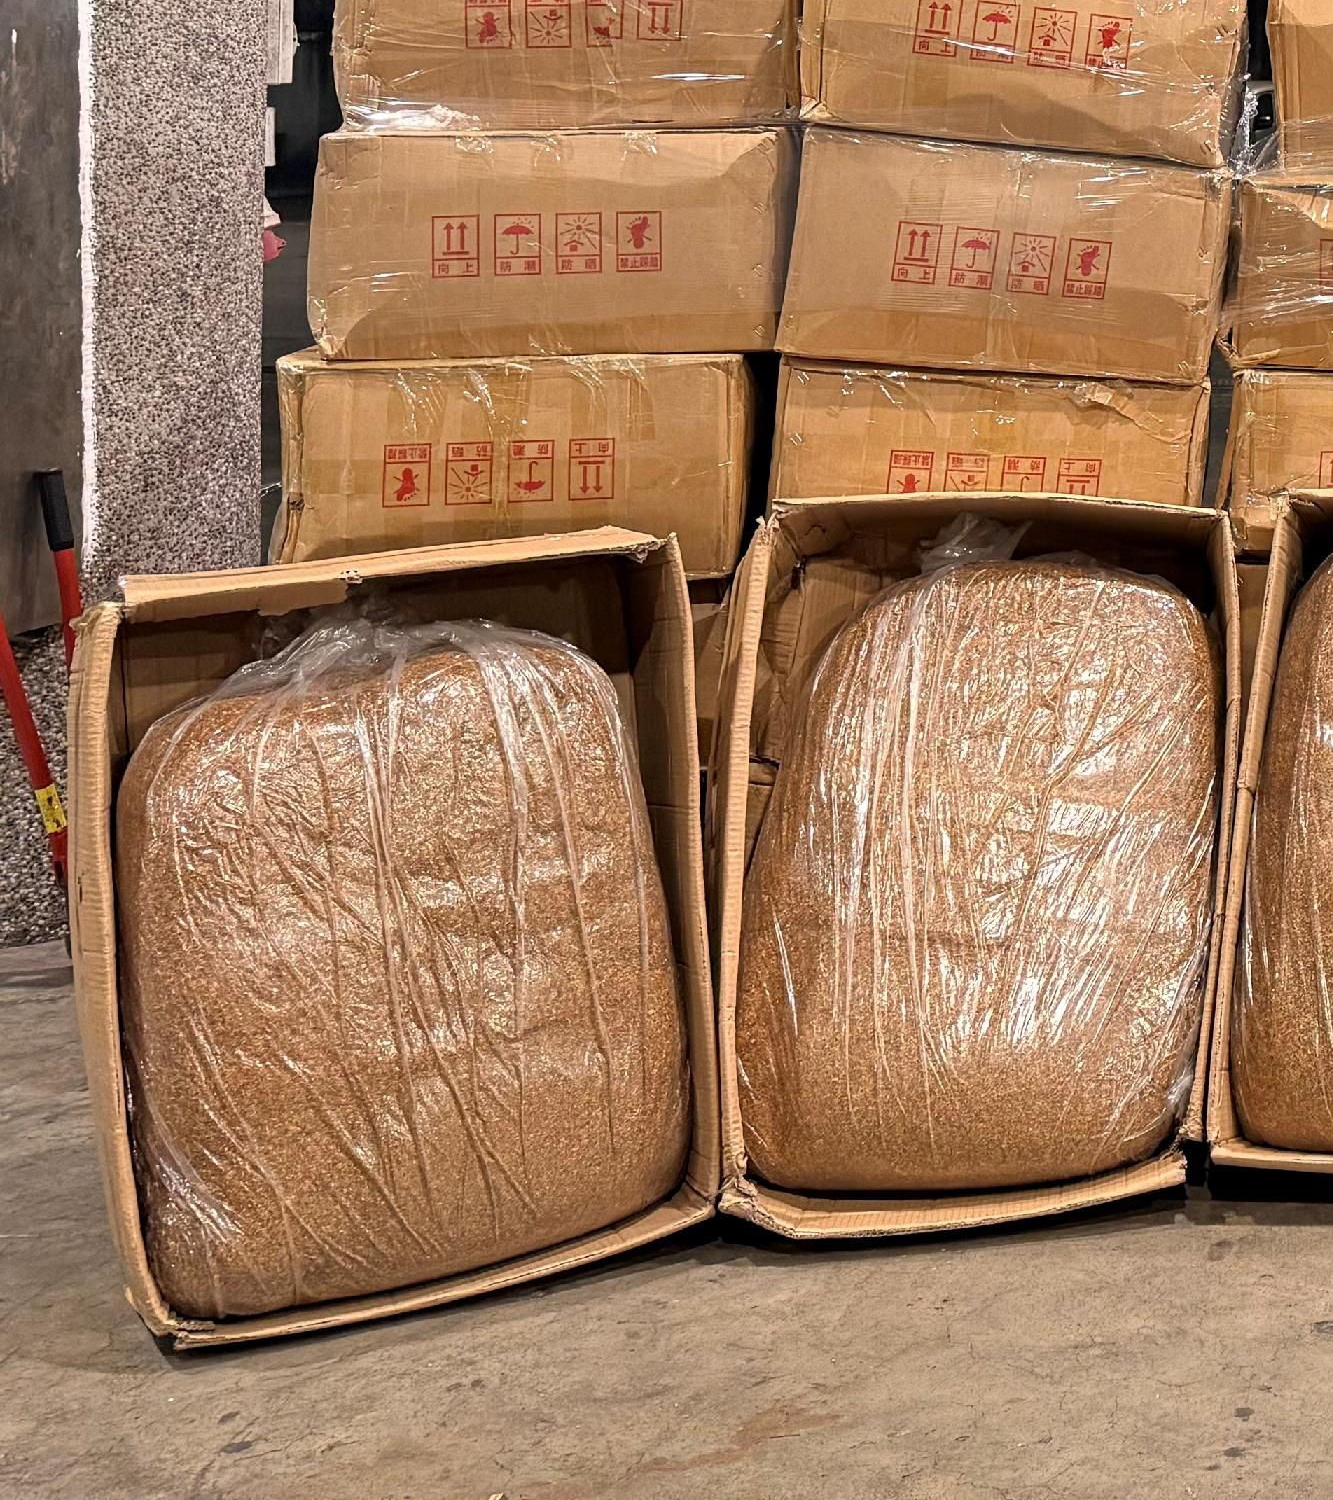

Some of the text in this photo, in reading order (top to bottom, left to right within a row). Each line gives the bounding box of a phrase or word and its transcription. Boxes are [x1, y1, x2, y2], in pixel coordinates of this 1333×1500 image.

[438, 261, 474, 274] 向上
[500, 260, 537, 272] 防潮
[562, 259, 598, 270] 防晒
[898, 267, 930, 280] 向上
[954, 272, 989, 286] 防潮
[574, 442, 609, 454] 向上
[1008, 459, 1041, 471] 防潮
[1063, 461, 1096, 473] 向上
